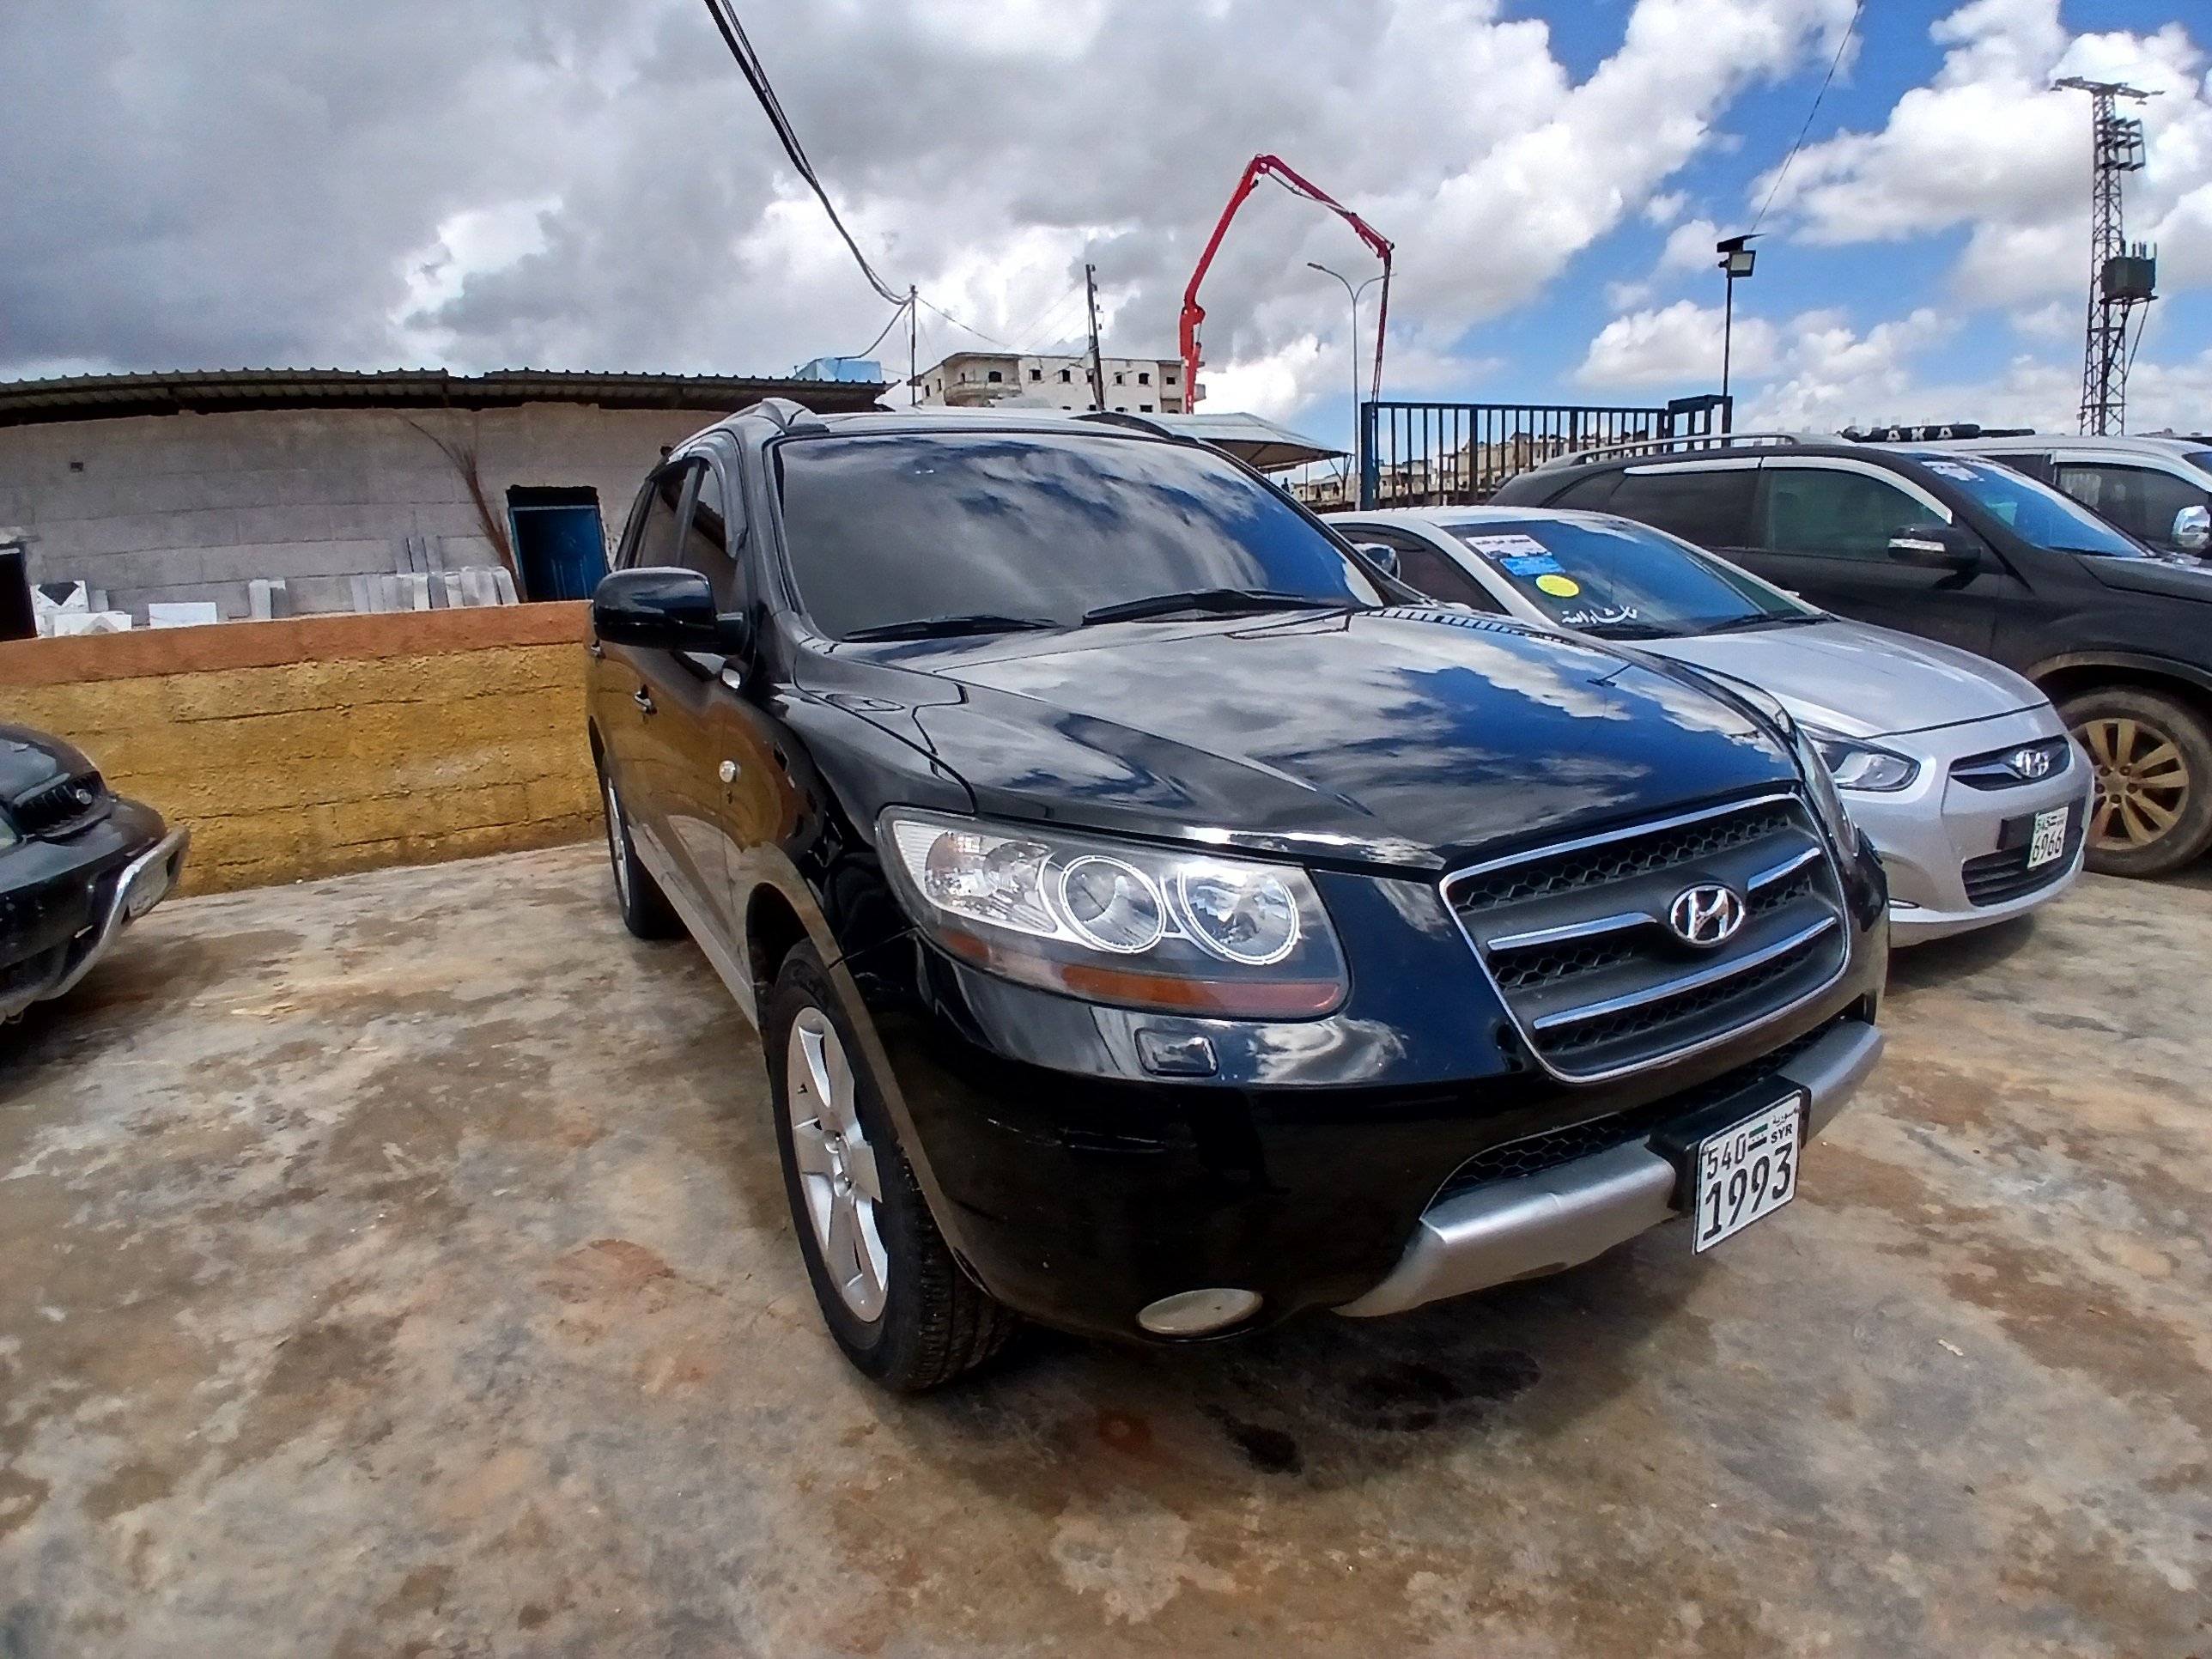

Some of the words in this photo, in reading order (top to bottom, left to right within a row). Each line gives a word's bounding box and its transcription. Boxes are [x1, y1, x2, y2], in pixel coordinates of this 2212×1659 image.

[2033, 830, 2063, 861] 6966
[1771, 1123, 1793, 1144] SYR
[1707, 1133, 1746, 1180] 540
[1703, 1143, 1793, 1241] 1993
